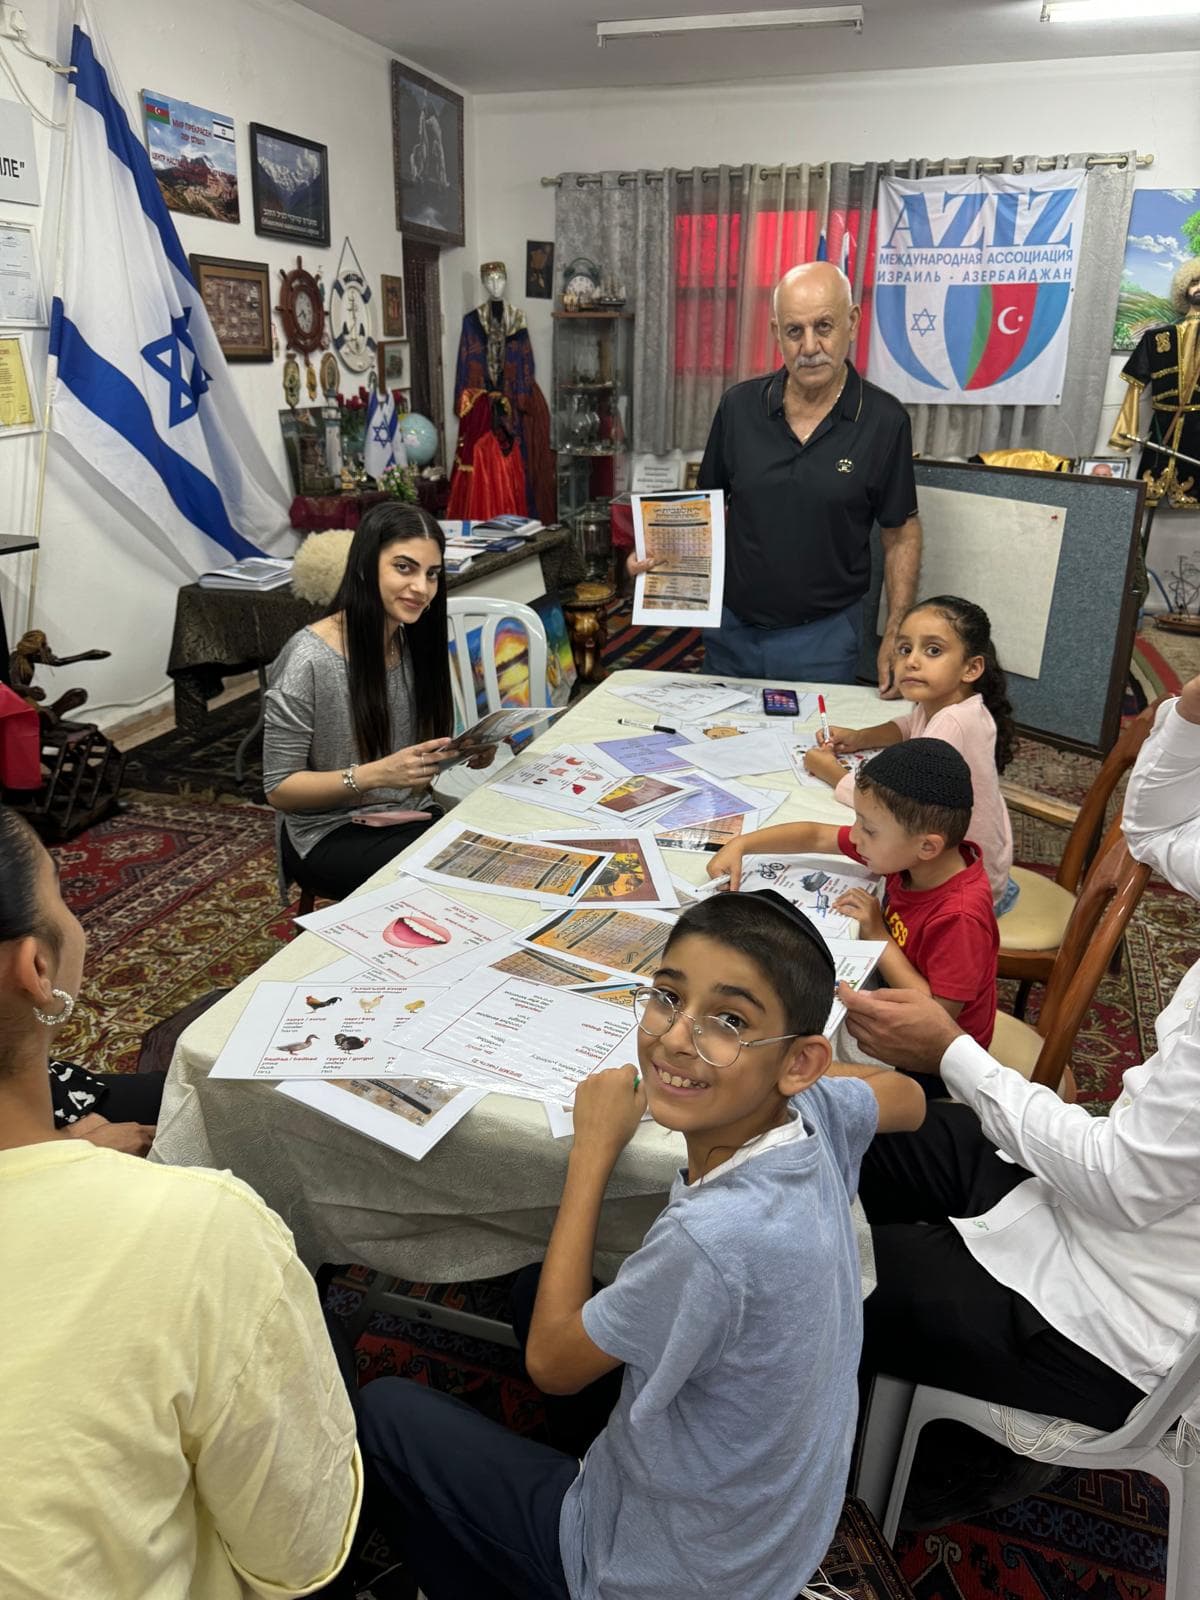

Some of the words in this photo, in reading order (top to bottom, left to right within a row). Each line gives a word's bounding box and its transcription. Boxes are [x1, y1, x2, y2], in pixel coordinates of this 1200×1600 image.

[882, 188, 1078, 250] AZIZ
[879, 249, 982, 266] МЕЖДУНАРОДНАЯ
[987, 249, 1073, 264] АССОЦИАЦИЯ
[877, 271, 941, 283] ИЗРАИЛЬ
[962, 267, 1072, 283] АЗЕРБАЙДЖАН
